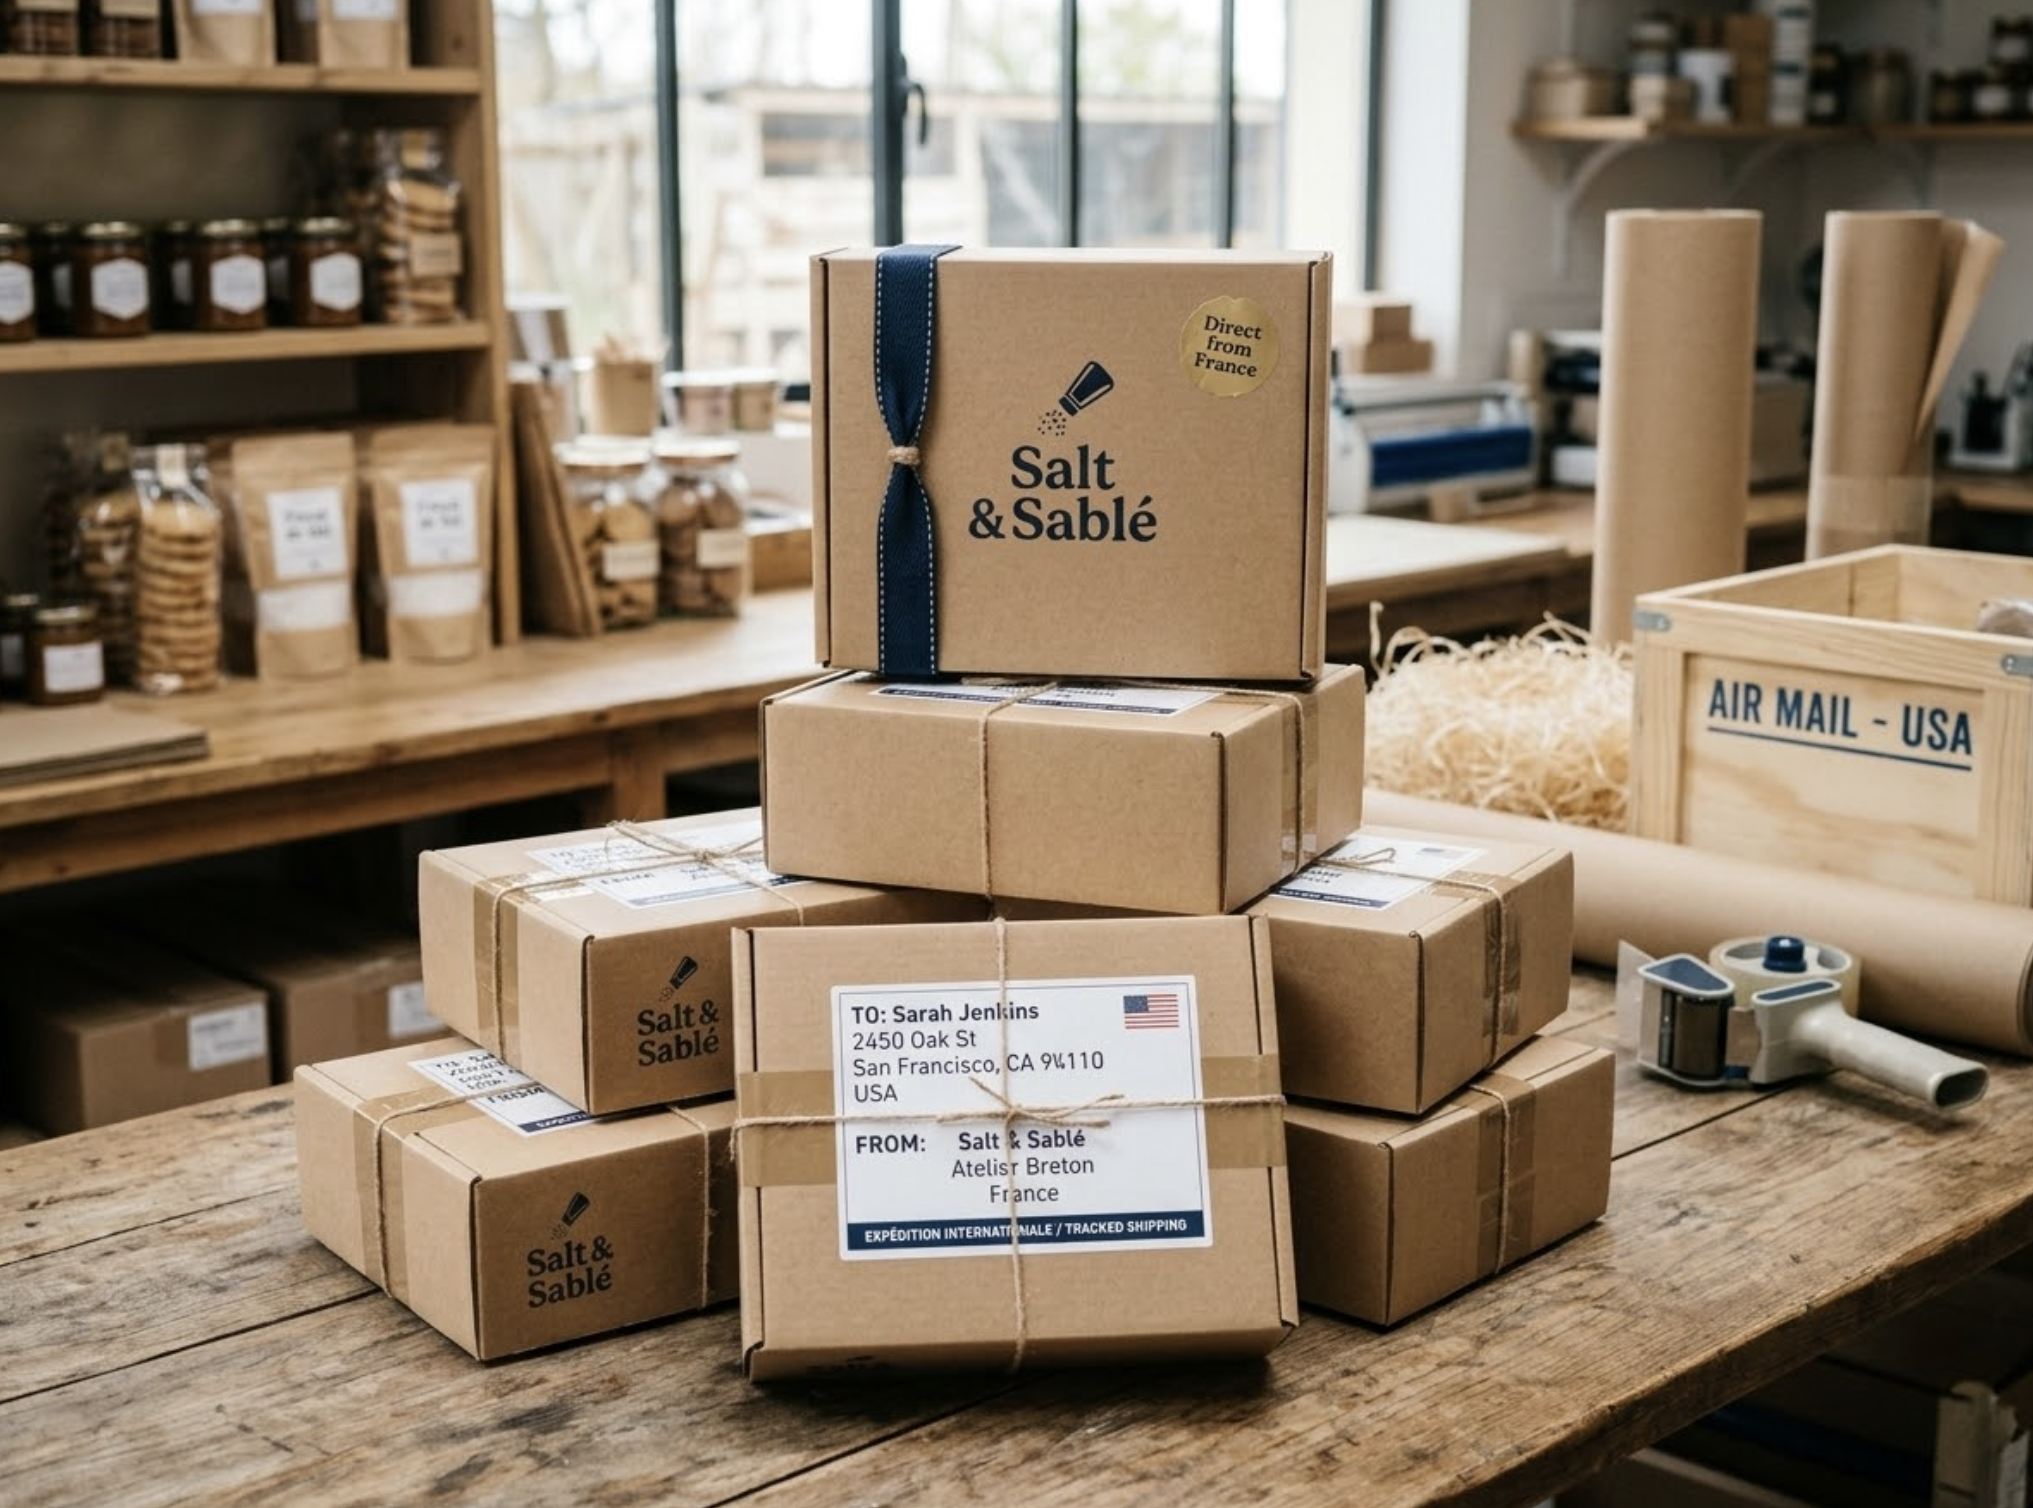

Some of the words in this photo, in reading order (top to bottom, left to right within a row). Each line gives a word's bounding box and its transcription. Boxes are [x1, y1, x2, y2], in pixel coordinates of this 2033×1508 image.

[1204, 315, 1262, 340] Direct
[1206, 335, 1252, 358] from
[1194, 351, 1257, 377] France
[1011, 444, 1115, 490] Salt
[1709, 678, 1762, 724] AIR
[1776, 687, 1858, 738] MAIL
[1872, 718, 1888, 726] -
[1902, 704, 1973, 756] USA
[637, 1003, 695, 1036] Salt
[699, 999, 720, 1025] &
[851, 1006, 886, 1024] TO:
[893, 1004, 952, 1022] Sarah
[958, 1001, 1039, 1021] Jenkins
[638, 1026, 719, 1067] Sablé
[852, 1031, 904, 1050] 2450
[911, 1030, 949, 1048] Oak
[955, 1029, 976, 1047] St
[853, 1058, 891, 1077] San
[898, 1055, 1000, 1075] Francisco,
[1006, 1053, 1034, 1071] CA
[854, 1083, 898, 1103] USA
[856, 1134, 925, 1153] FROM:
[958, 1132, 1000, 1150] Salt
[1027, 1129, 1086, 1148] Sablé
[1026, 1157, 1095, 1176] Breton
[990, 1184, 1059, 1203] France
[864, 1226, 941, 1243] EXPÉDITION
[944, 1224, 1053, 1239] INTERNATINALE
[1065, 1221, 1124, 1234] TRACKED
[1126, 1219, 1187, 1232] SHIPPING
[527, 1240, 587, 1277] Salt
[591, 1235, 614, 1261] &
[528, 1264, 612, 1308] Sablé
